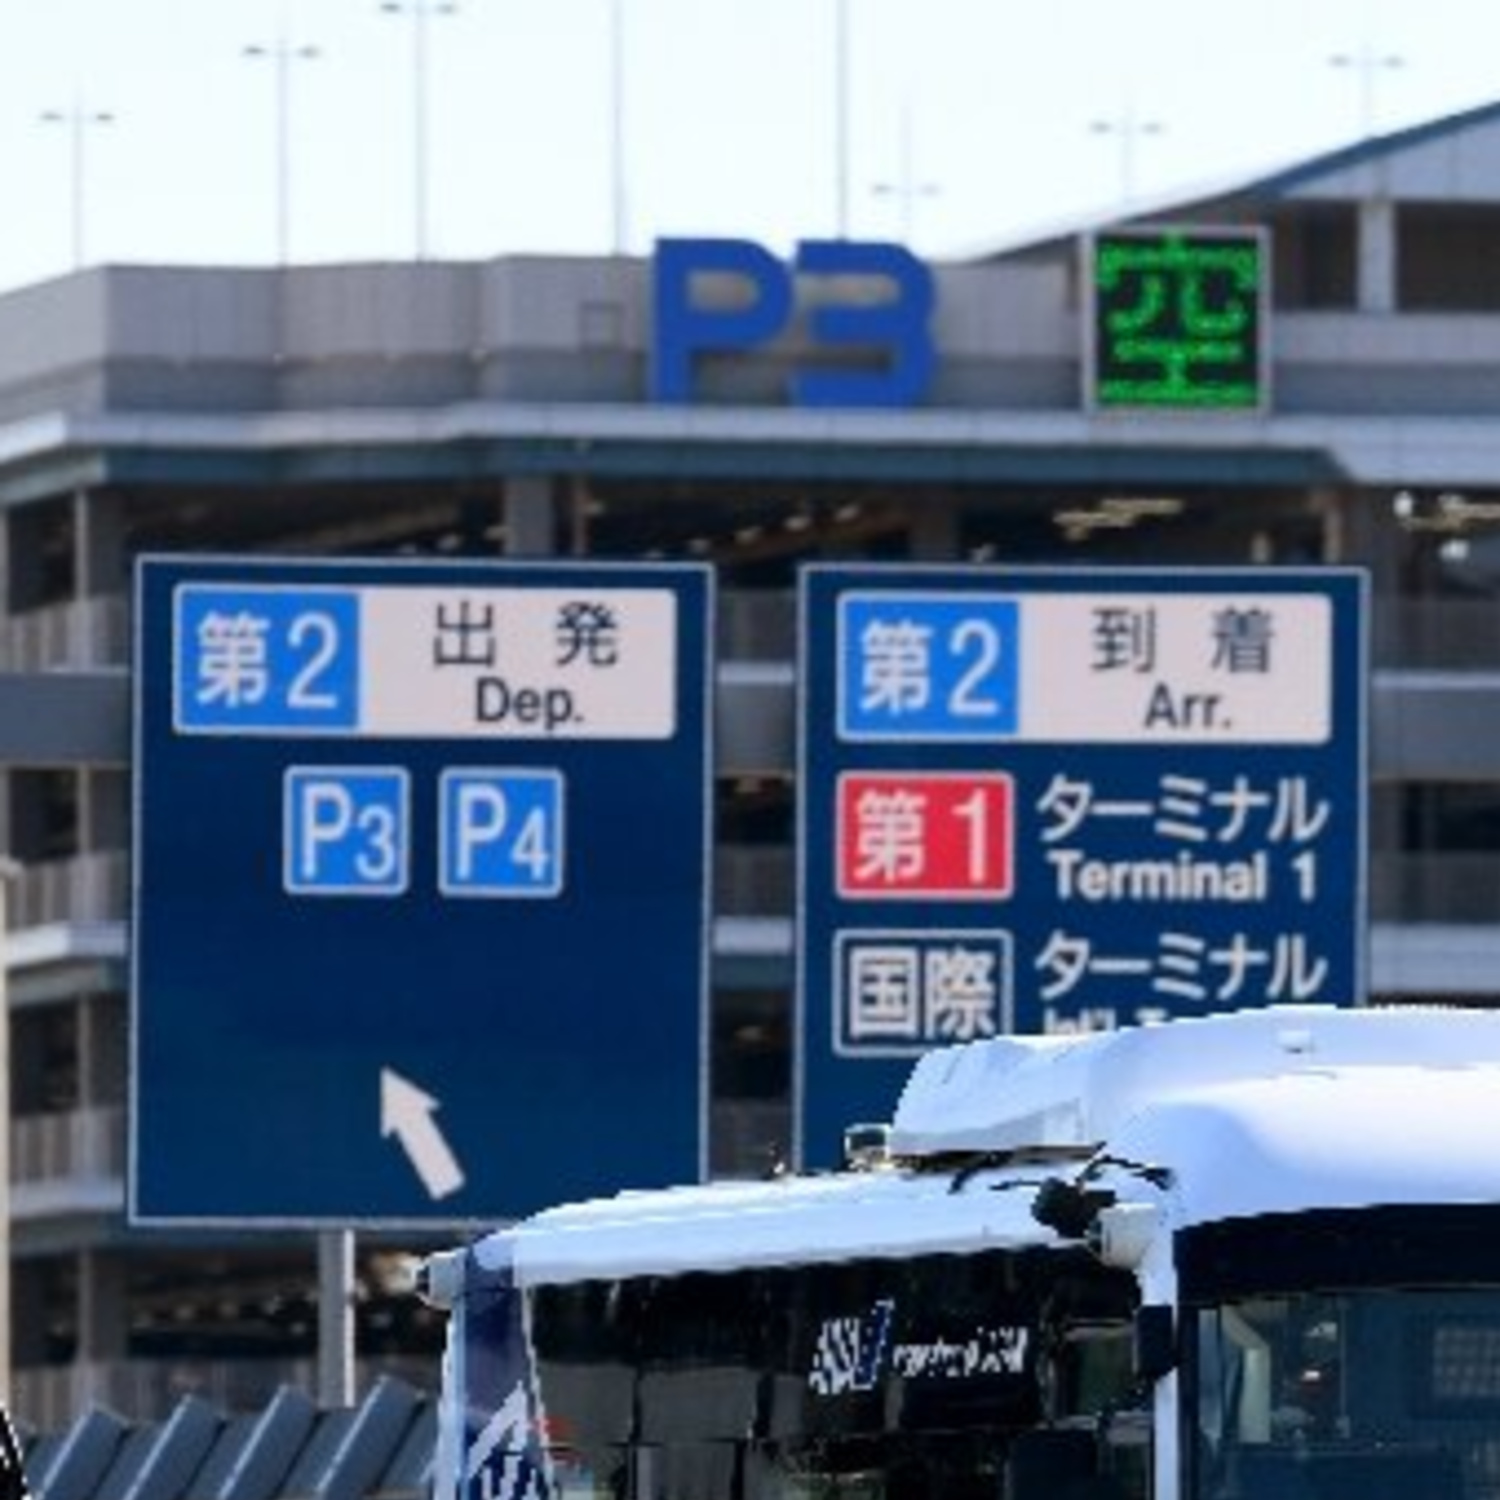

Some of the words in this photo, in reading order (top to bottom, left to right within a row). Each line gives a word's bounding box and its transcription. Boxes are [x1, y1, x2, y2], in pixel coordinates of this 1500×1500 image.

[648, 238, 939, 407] P3
[1099, 231, 1263, 400] 空
[195, 612, 339, 709] 第2
[432, 600, 618, 667] 出発
[860, 619, 998, 716] 第2
[1091, 607, 1275, 673] 到着
[475, 677, 584, 731] Dep.
[1143, 683, 1232, 729] Arr.
[301, 783, 396, 880] P3
[456, 783, 550, 881] P4
[854, 787, 989, 885] 第1
[1036, 774, 1329, 843] ターミナル
[1046, 850, 1266, 899] Terminal
[1293, 852, 1316, 898] 1
[847, 946, 996, 1040] 国際
[1034, 931, 1328, 998] ターミナル
